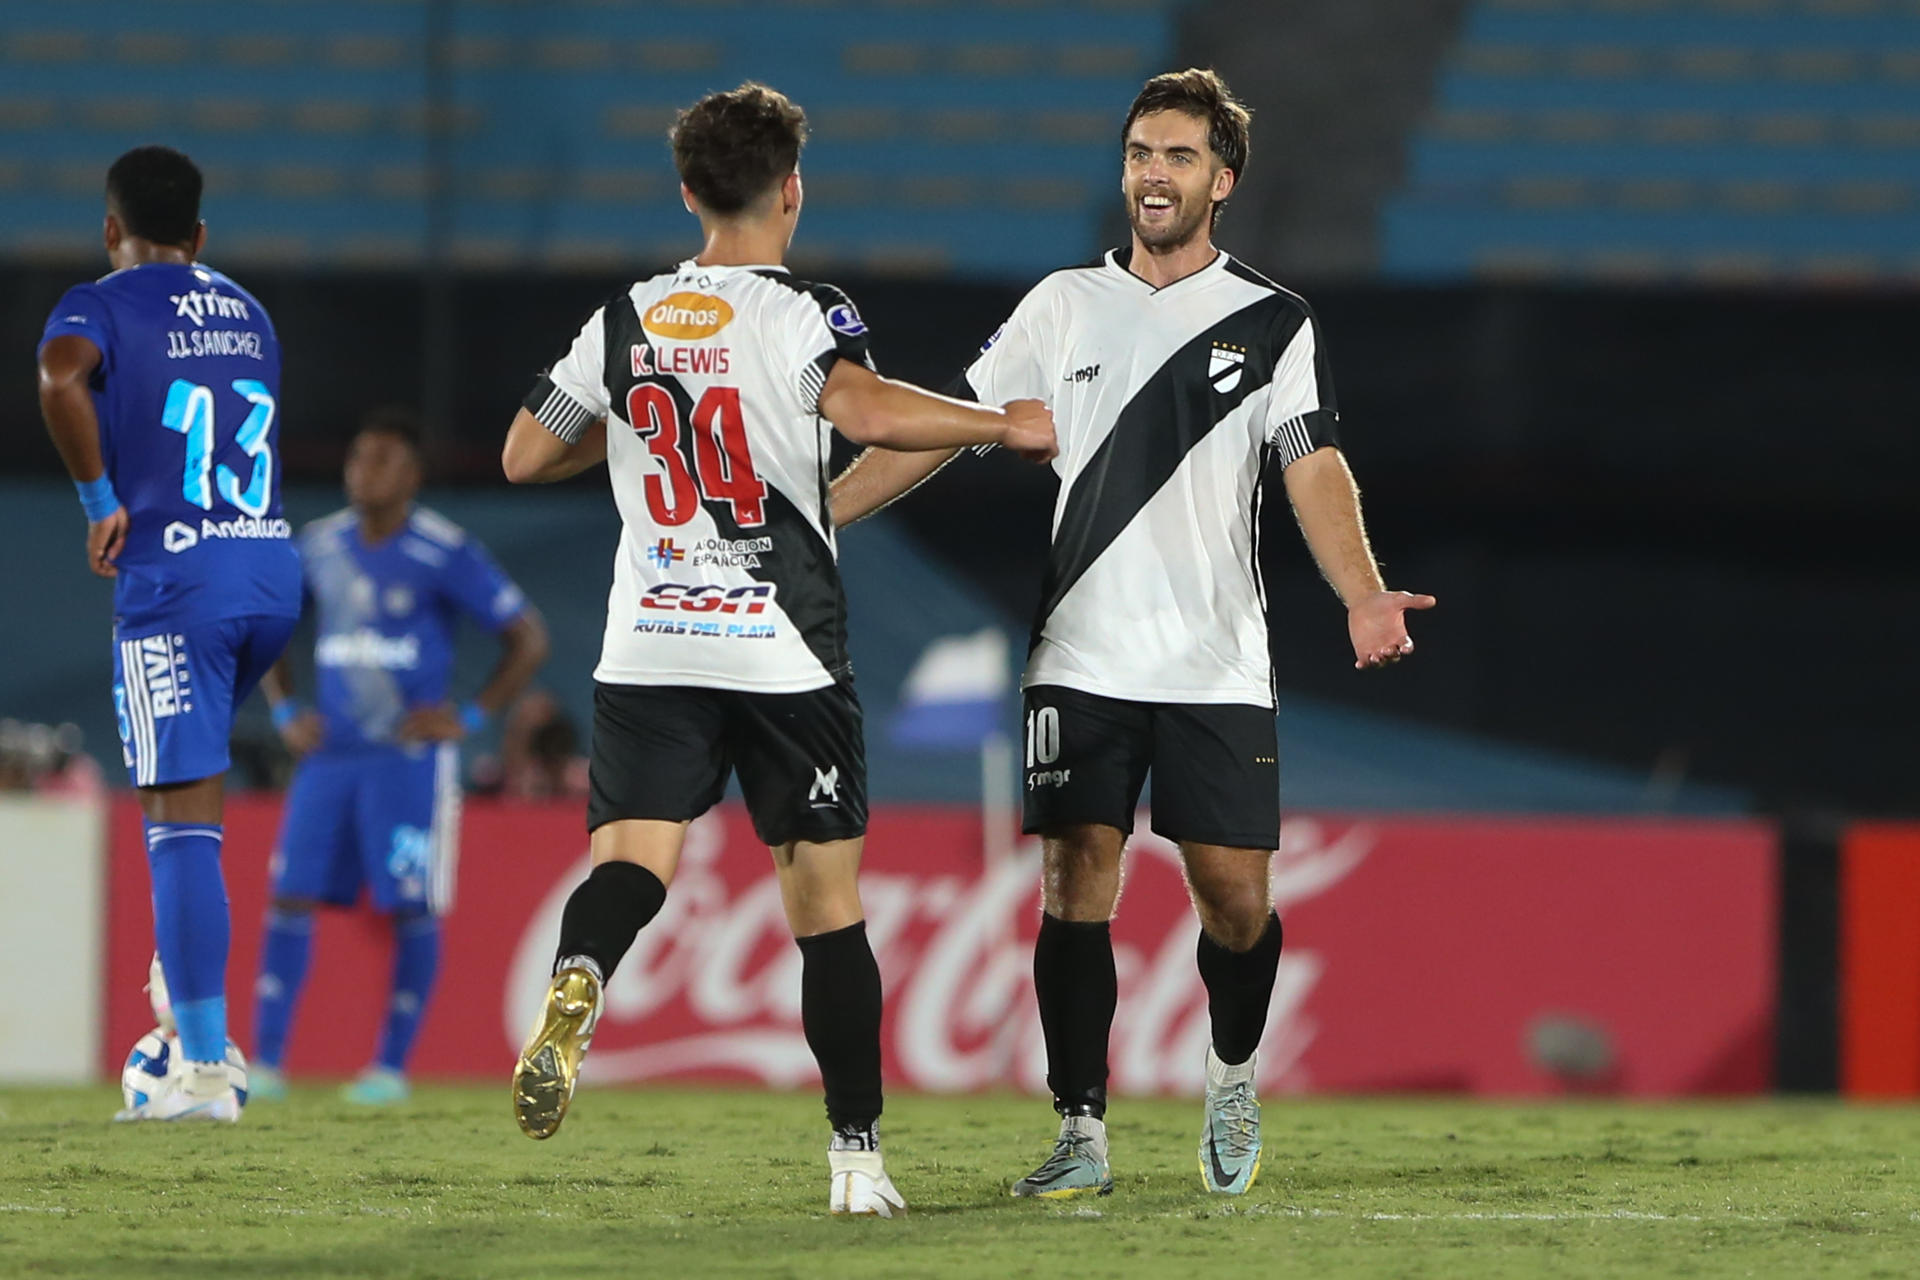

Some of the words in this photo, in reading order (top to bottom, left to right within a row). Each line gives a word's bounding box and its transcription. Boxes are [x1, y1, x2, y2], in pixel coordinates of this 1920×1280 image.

[651, 304, 718, 326] Olmos
[162, 378, 276, 517] 13
[626, 382, 768, 528] 34
[694, 537, 772, 554] AOCIACION
[633, 618, 688, 635] RUTAS
[690, 622, 721, 637] DEL
[725, 624, 777, 639] PLATA
[142, 634, 176, 719] RIVA
[1027, 706, 1060, 768] 10
[1037, 769, 1070, 788] mgr
